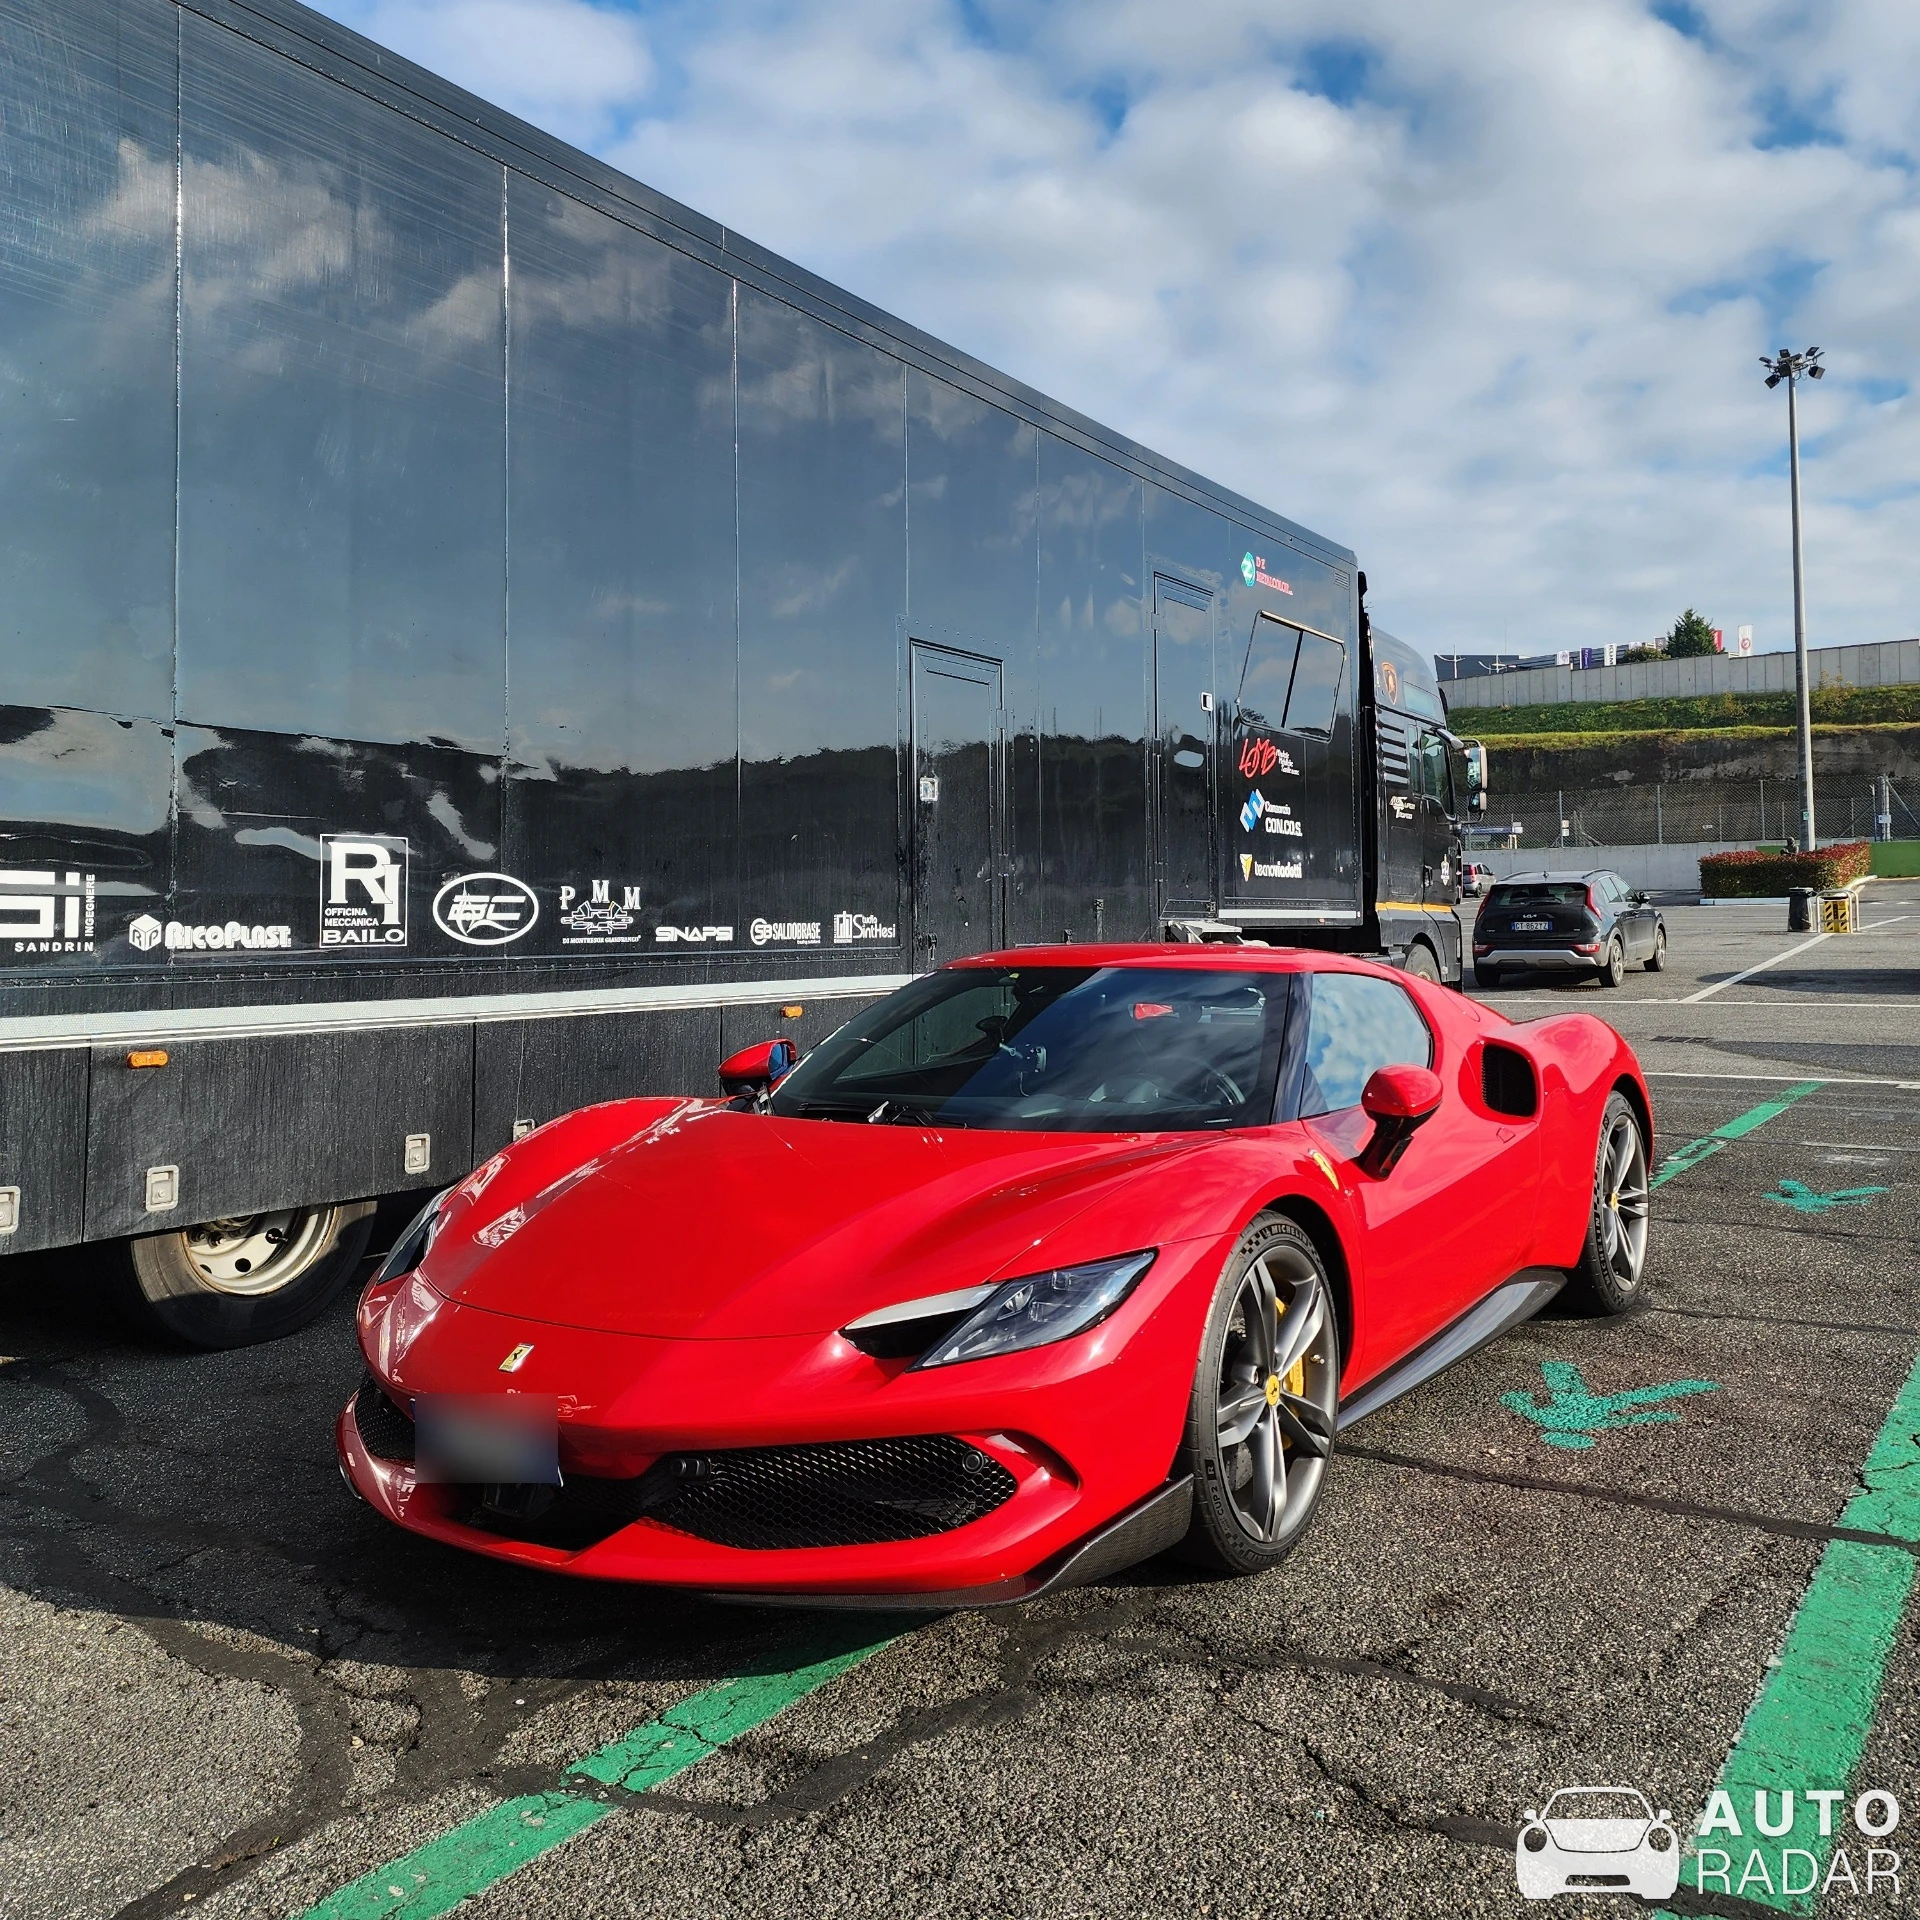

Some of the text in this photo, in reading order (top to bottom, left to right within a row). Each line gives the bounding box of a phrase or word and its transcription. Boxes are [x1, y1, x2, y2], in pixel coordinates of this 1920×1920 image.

[85, 873, 95, 937] INGEGNERE
[324, 907, 368, 916] OFFICINA
[324, 918, 380, 927] MECCANICA
[322, 928, 405, 943] BAILO
[772, 922, 821, 940] SALDOBRASE
[14, 941, 94, 952] SANDRIN
[1207, 1465, 1215, 1475] R
[1212, 1495, 1224, 1516] CUP
